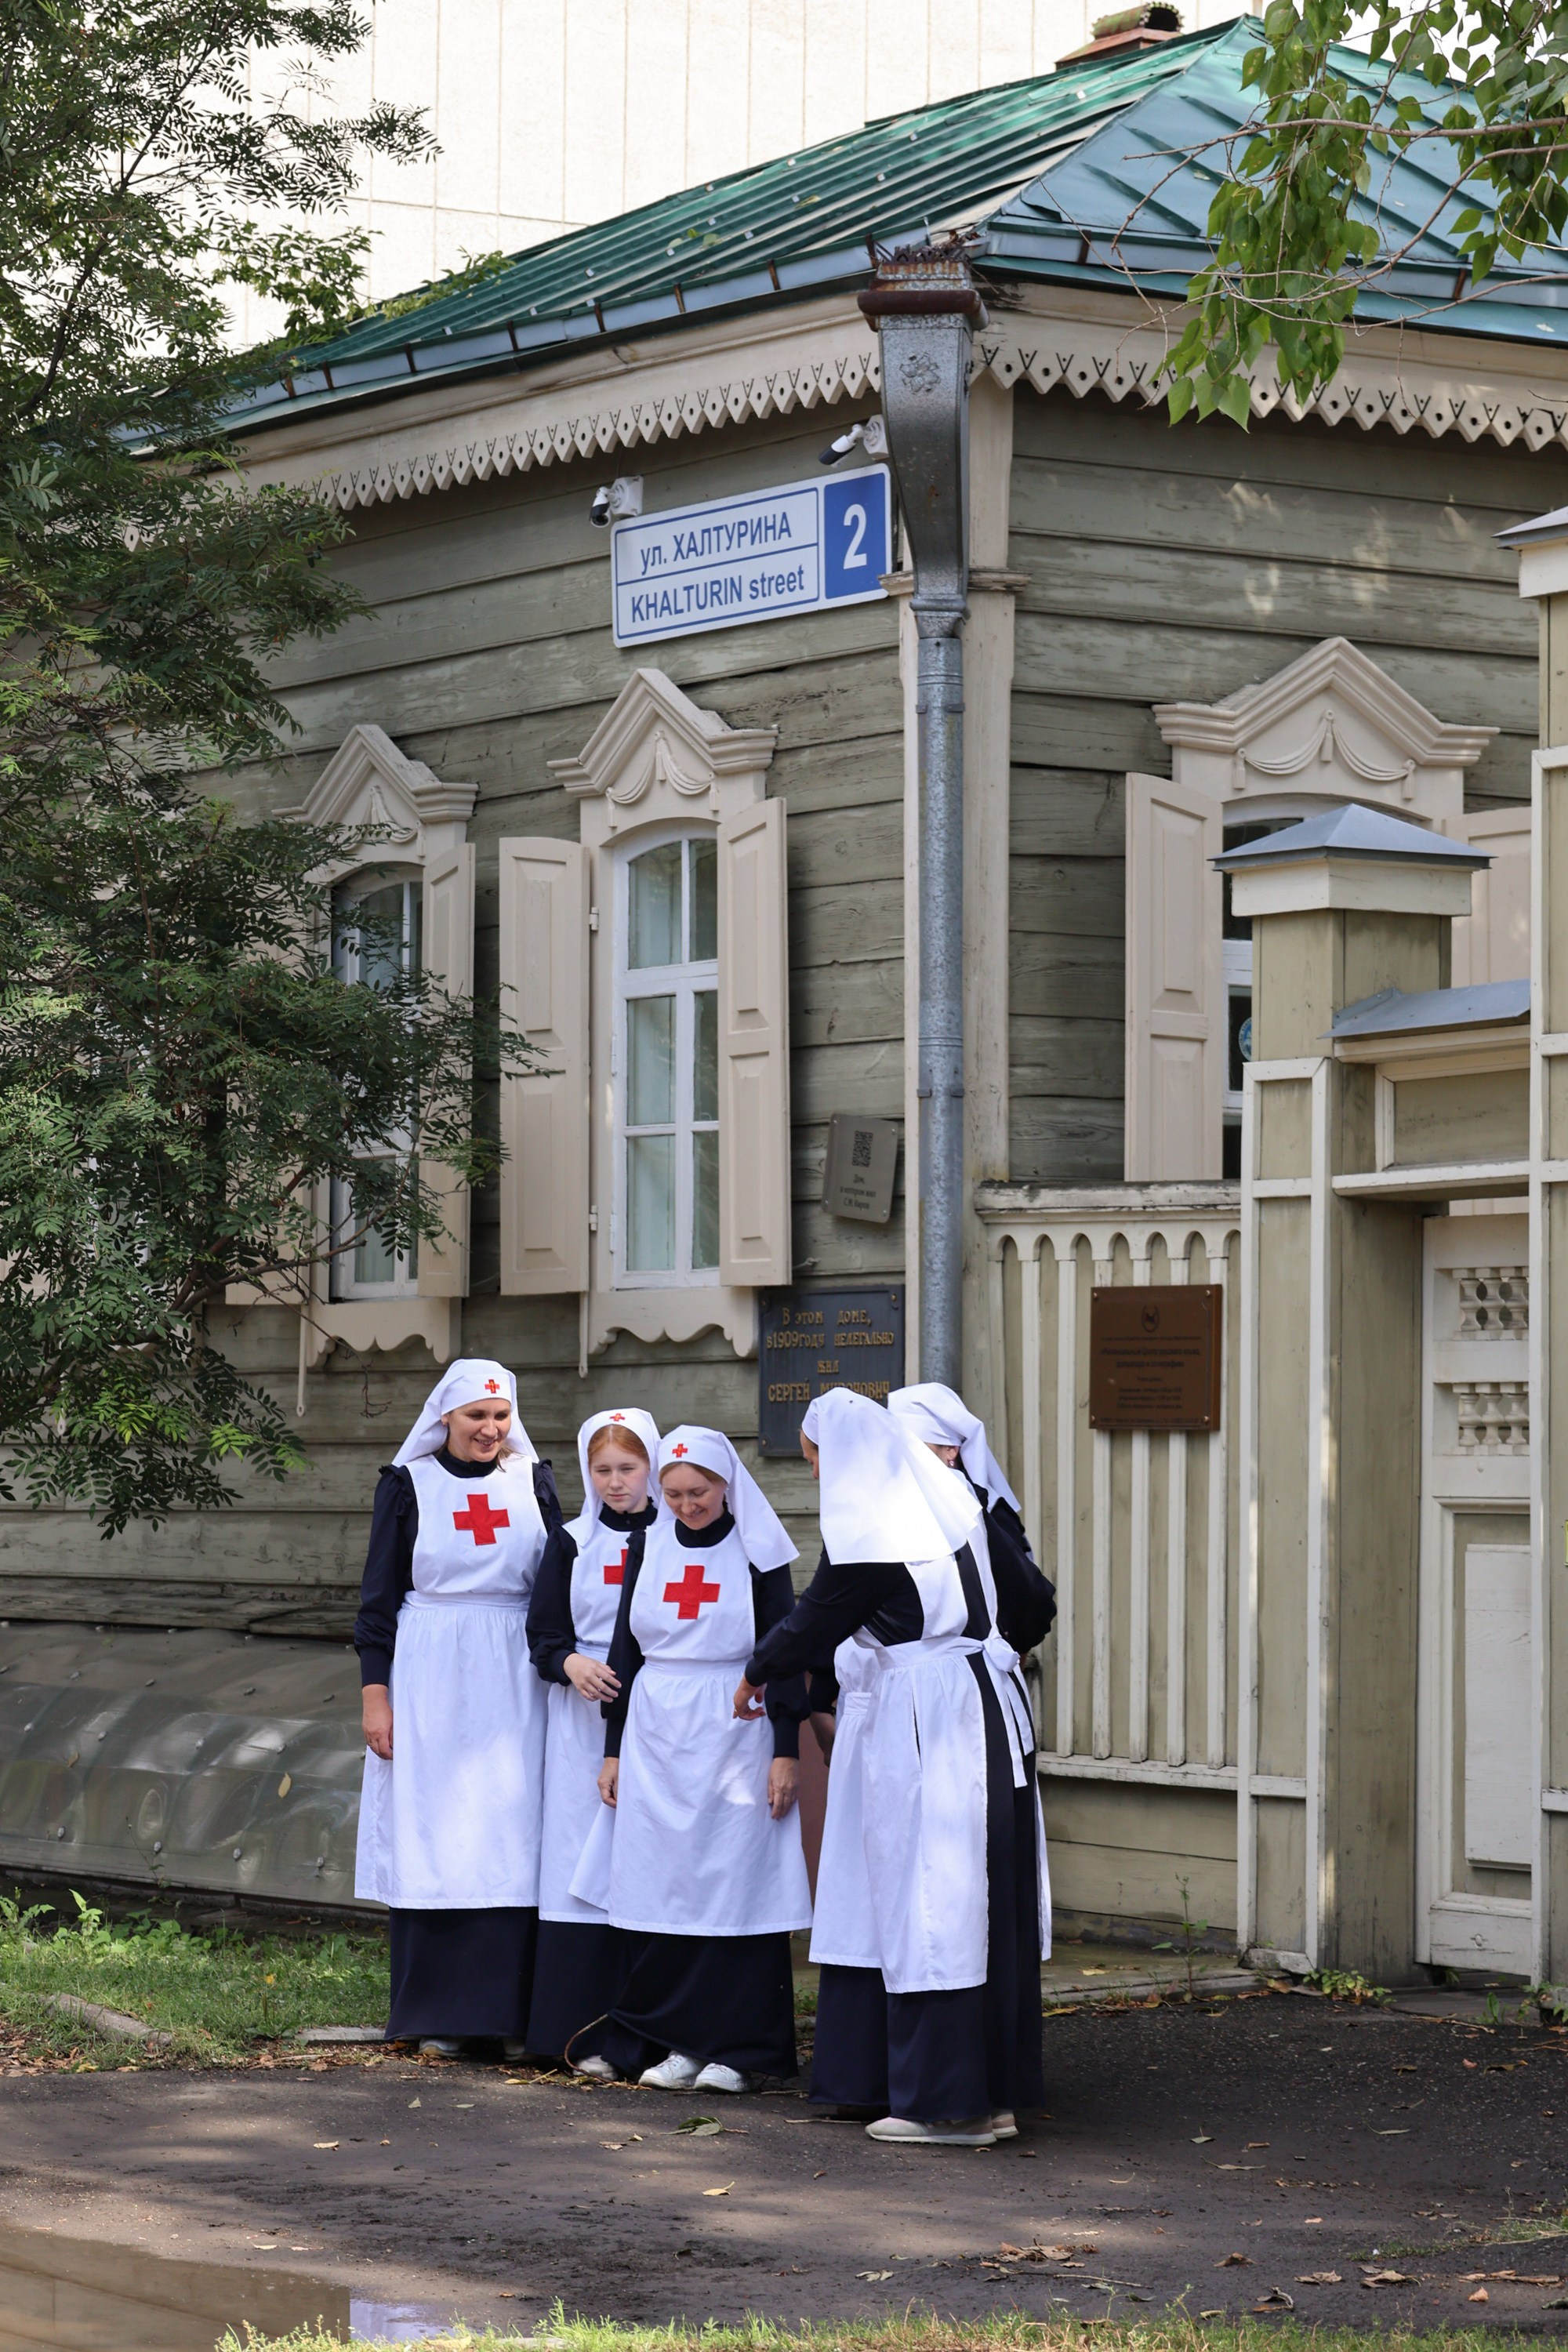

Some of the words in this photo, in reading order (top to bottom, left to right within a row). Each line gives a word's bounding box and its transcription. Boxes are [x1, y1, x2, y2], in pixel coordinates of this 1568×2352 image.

[641, 543, 667, 575] ул.
[673, 511, 792, 561] ХАЛТУРИНА
[843, 503, 868, 570] 2
[631, 575, 742, 622] KHALTURIN
[750, 564, 804, 600] street
[782, 1307, 791, 1326] В
[768, 1377, 811, 1402] СЕРГЕЙ
